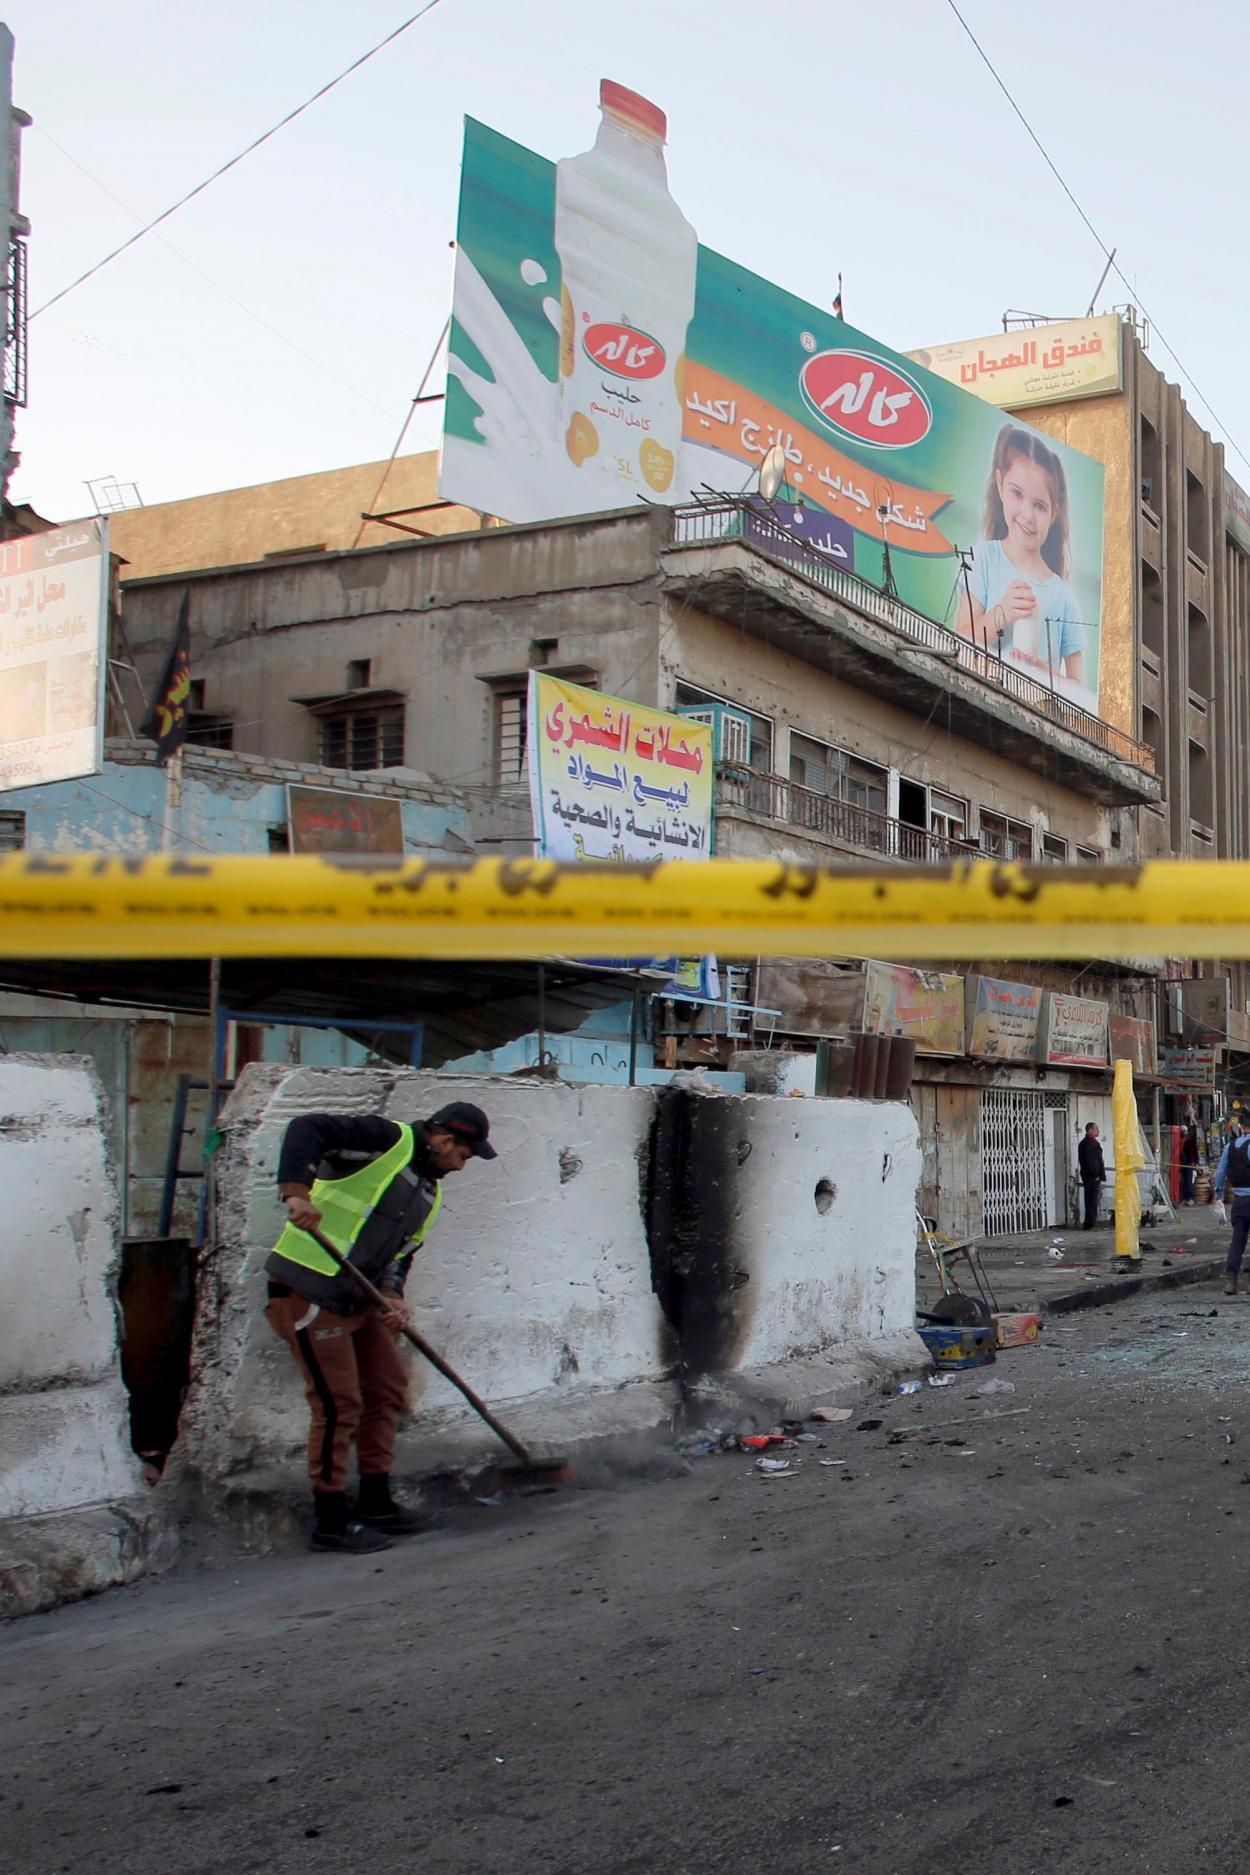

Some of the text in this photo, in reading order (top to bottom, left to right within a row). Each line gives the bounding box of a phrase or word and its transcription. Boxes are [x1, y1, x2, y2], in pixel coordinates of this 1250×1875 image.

[960, 332, 1102, 384] فندق الهجان
[601, 382, 642, 404] حليب
[686, 392, 737, 428] اكيد
[590, 400, 653, 431] كامل الدسم
[876, 497, 929, 532] شكل
[45, 534, 90, 562] هيلتي
[546, 702, 703, 774] محلات الشمري
[567, 753, 690, 813] لبيع المواد
[551, 789, 621, 838] والصحية
[625, 808, 705, 849] الانشائية
